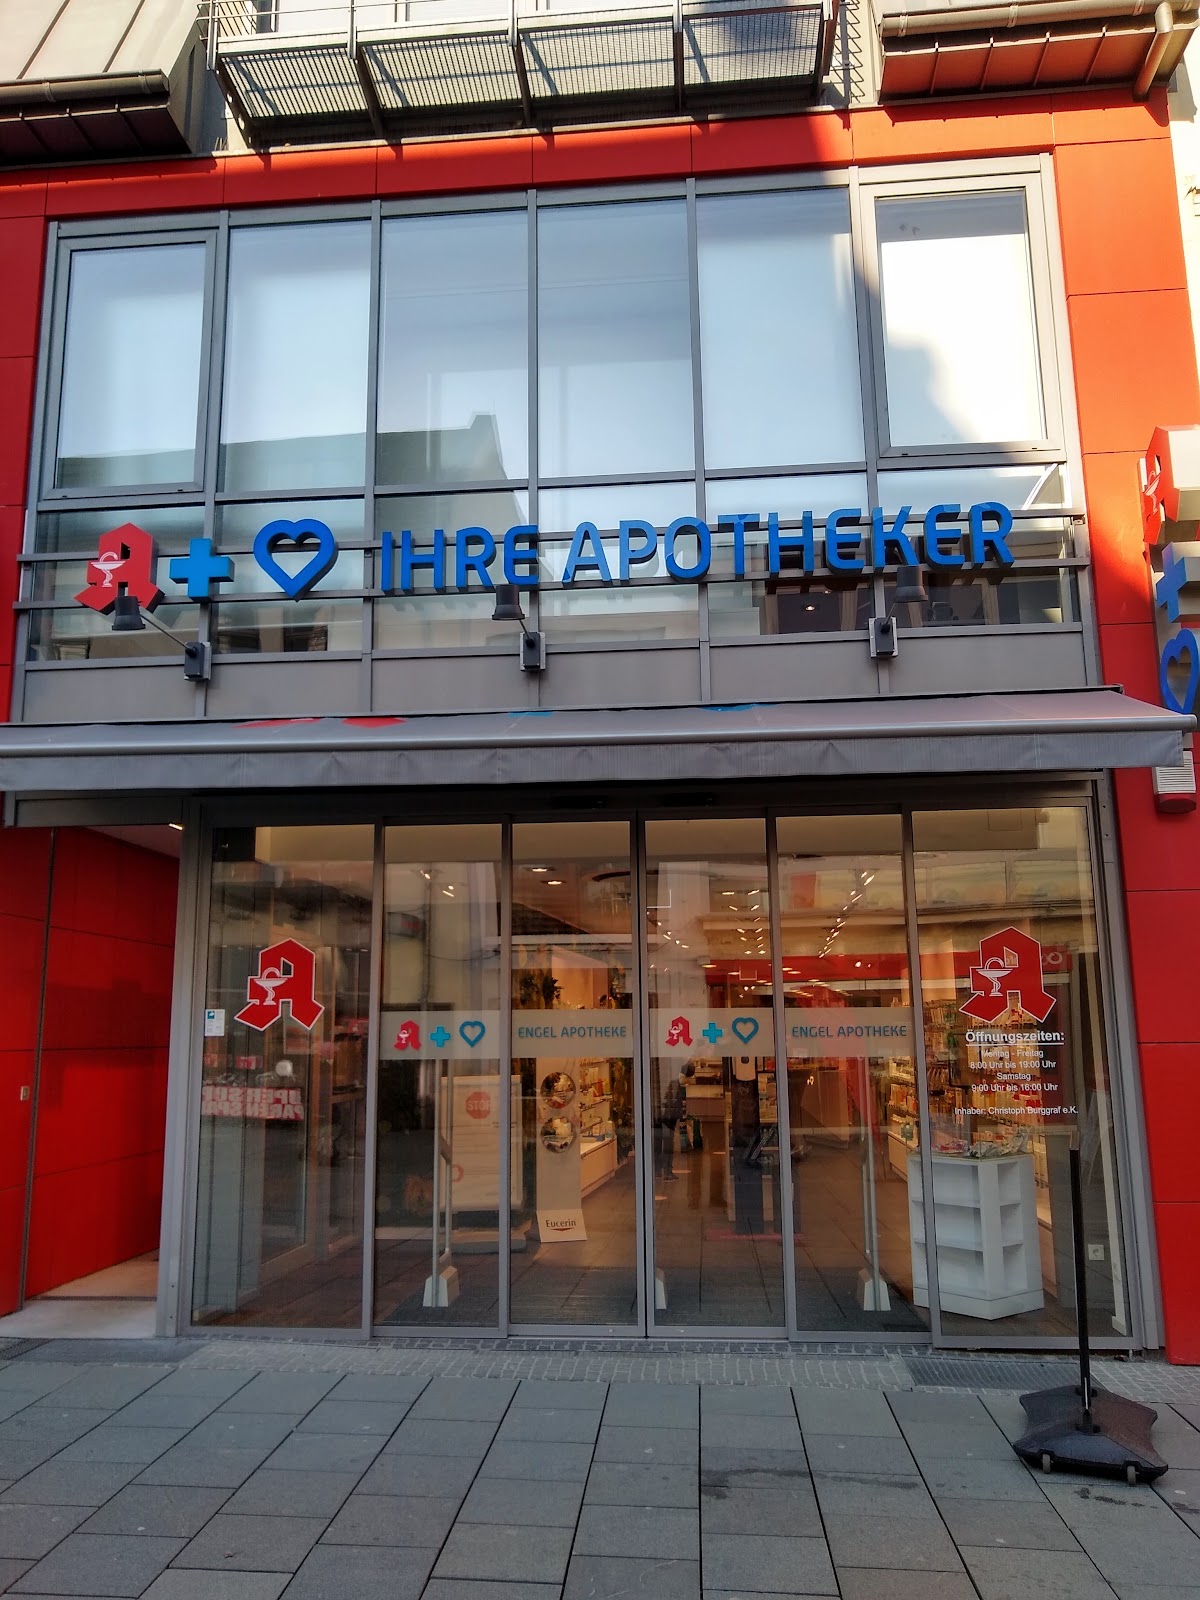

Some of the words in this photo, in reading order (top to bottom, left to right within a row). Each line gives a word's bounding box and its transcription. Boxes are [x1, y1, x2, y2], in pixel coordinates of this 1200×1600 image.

[380, 523, 540, 592] IHRE
[562, 501, 1015, 586] APOTHEKER
[518, 1026, 557, 1039] ENGEL
[560, 1025, 627, 1038] APOTHEKE
[792, 1025, 833, 1038] ENGEL
[837, 1025, 907, 1037] APOTHEKE
[965, 1029, 1065, 1044] Öffnungszeiten:
[1016, 1049, 1044, 1058] Freitag
[988, 1060, 1003, 1069] Uhr
[1005, 1060, 1017, 1069] bis
[1042, 1060, 1057, 1069] Uhr
[997, 1072, 1031, 1082] Samstag
[990, 1083, 1005, 1092] Uhr
[1006, 1083, 1018, 1092] bis
[1043, 1083, 1058, 1092] Uhr
[954, 1107, 986, 1115] Inhaber:
[988, 1106, 1025, 1116] Christoph
[1027, 1106, 1061, 1116] Burggraf
[1062, 1105, 1078, 1114] e.K.
[545, 1219, 577, 1228] Eucerin
